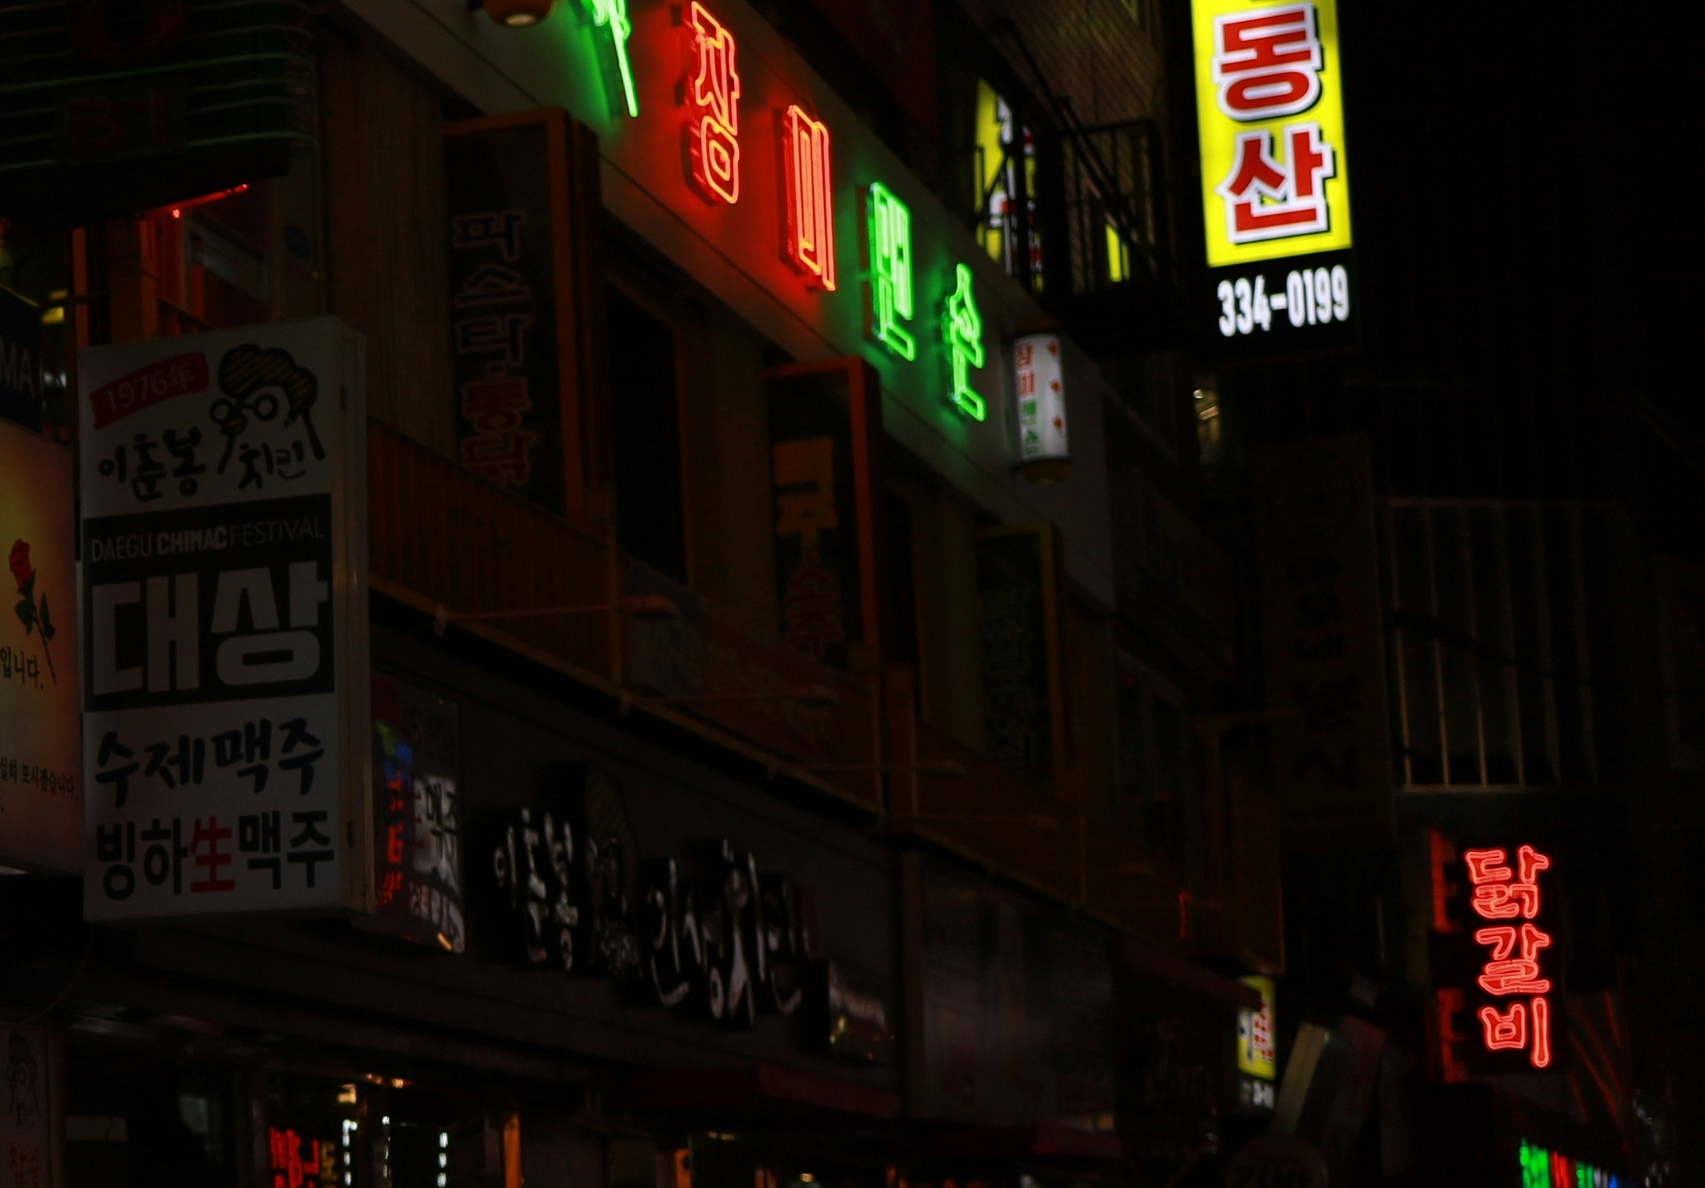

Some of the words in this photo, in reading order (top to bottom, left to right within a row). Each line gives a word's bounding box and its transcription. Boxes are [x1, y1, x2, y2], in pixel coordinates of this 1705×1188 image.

[1216, 263, 1351, 338] 334-0199
[103, 361, 195, 413] 1976年
[90, 534, 152, 563] DAEGU
[156, 525, 228, 555] CHIMAC
[230, 516, 326, 547] FESTIVAL
[0, 645, 45, 690] 입니다.
[92, 560, 330, 697] 대상
[96, 718, 324, 808] 수제맥주
[97, 811, 335, 901] 빙하生맥주
[1464, 844, 1552, 1069] 닭갈비
